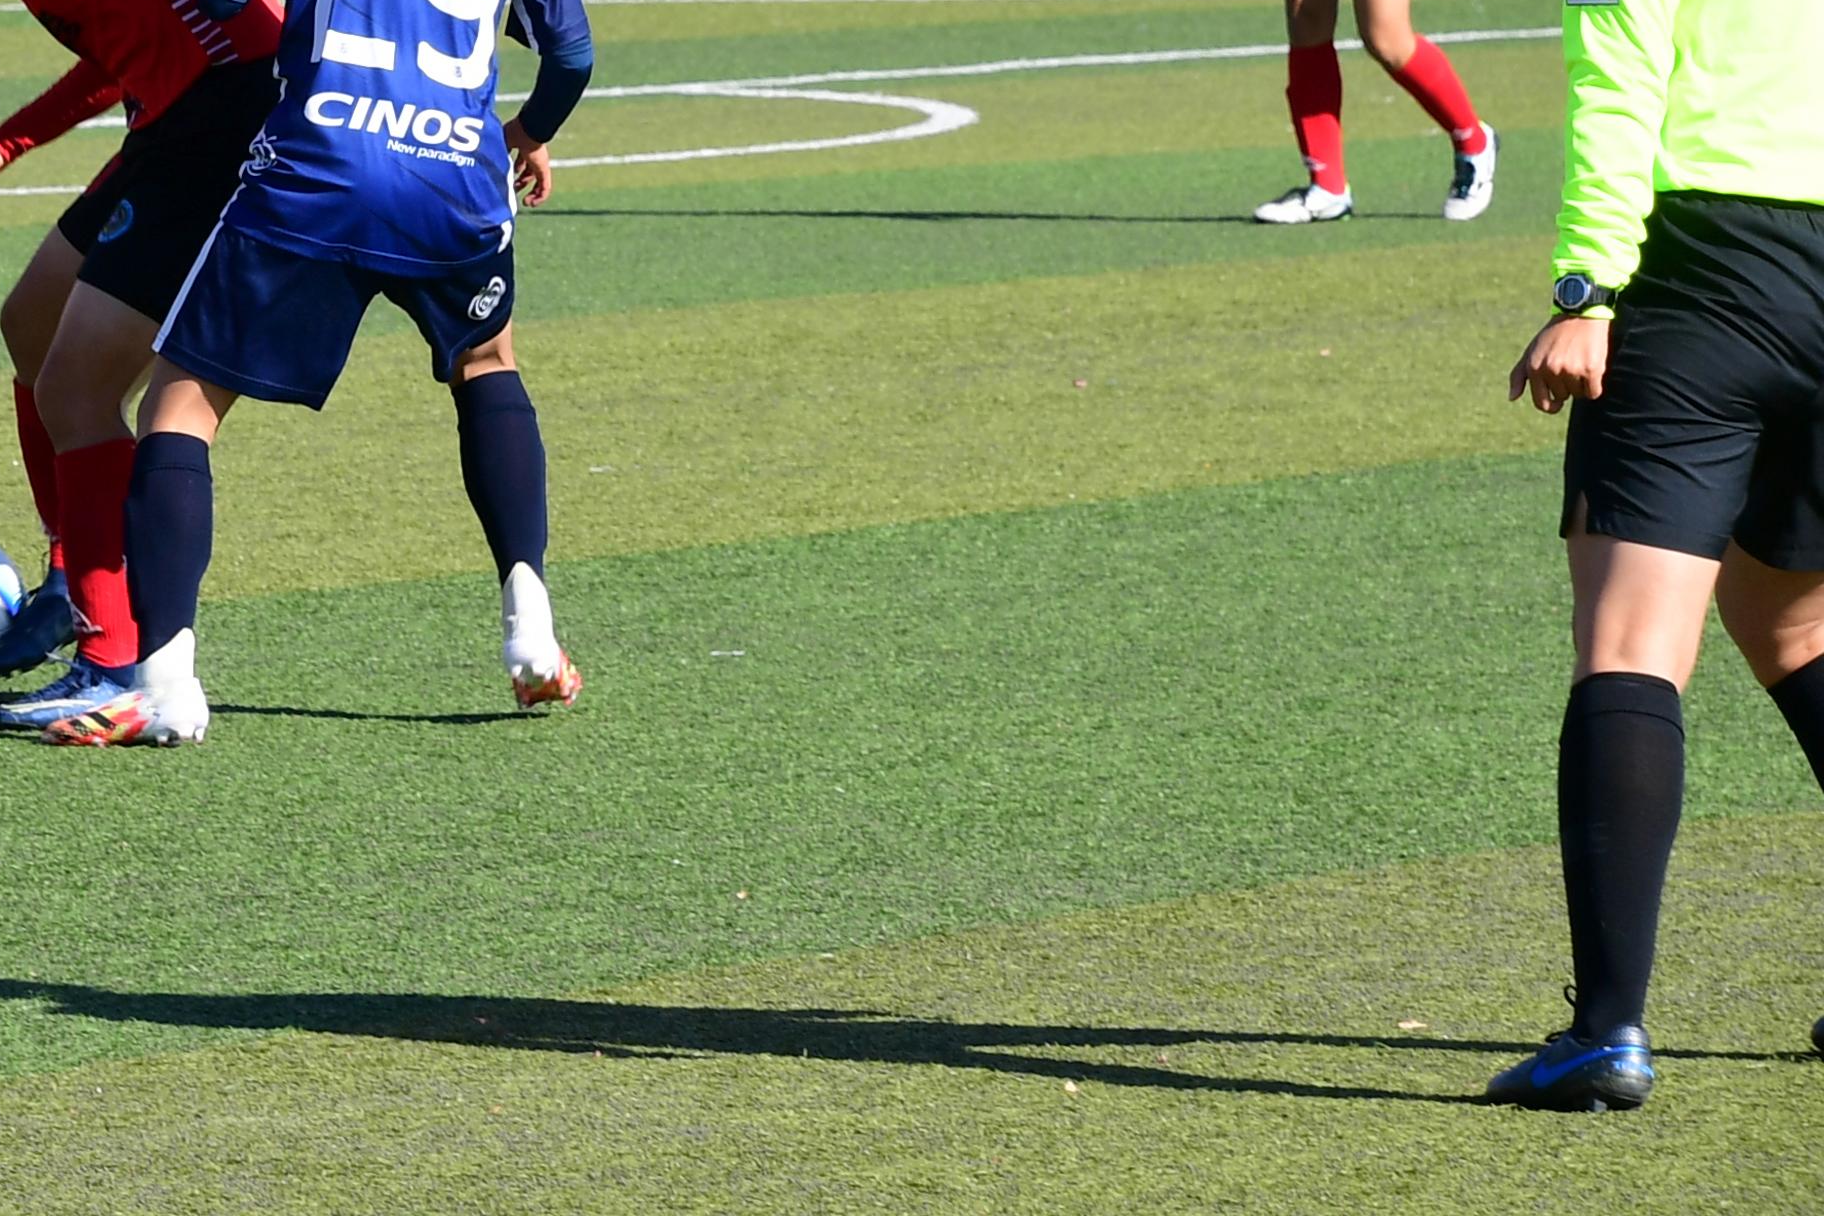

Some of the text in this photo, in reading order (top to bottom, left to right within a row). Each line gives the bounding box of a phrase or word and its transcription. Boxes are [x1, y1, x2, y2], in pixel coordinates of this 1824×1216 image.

[304, 91, 484, 153] CINOS
[387, 139, 475, 168] New paradigm
